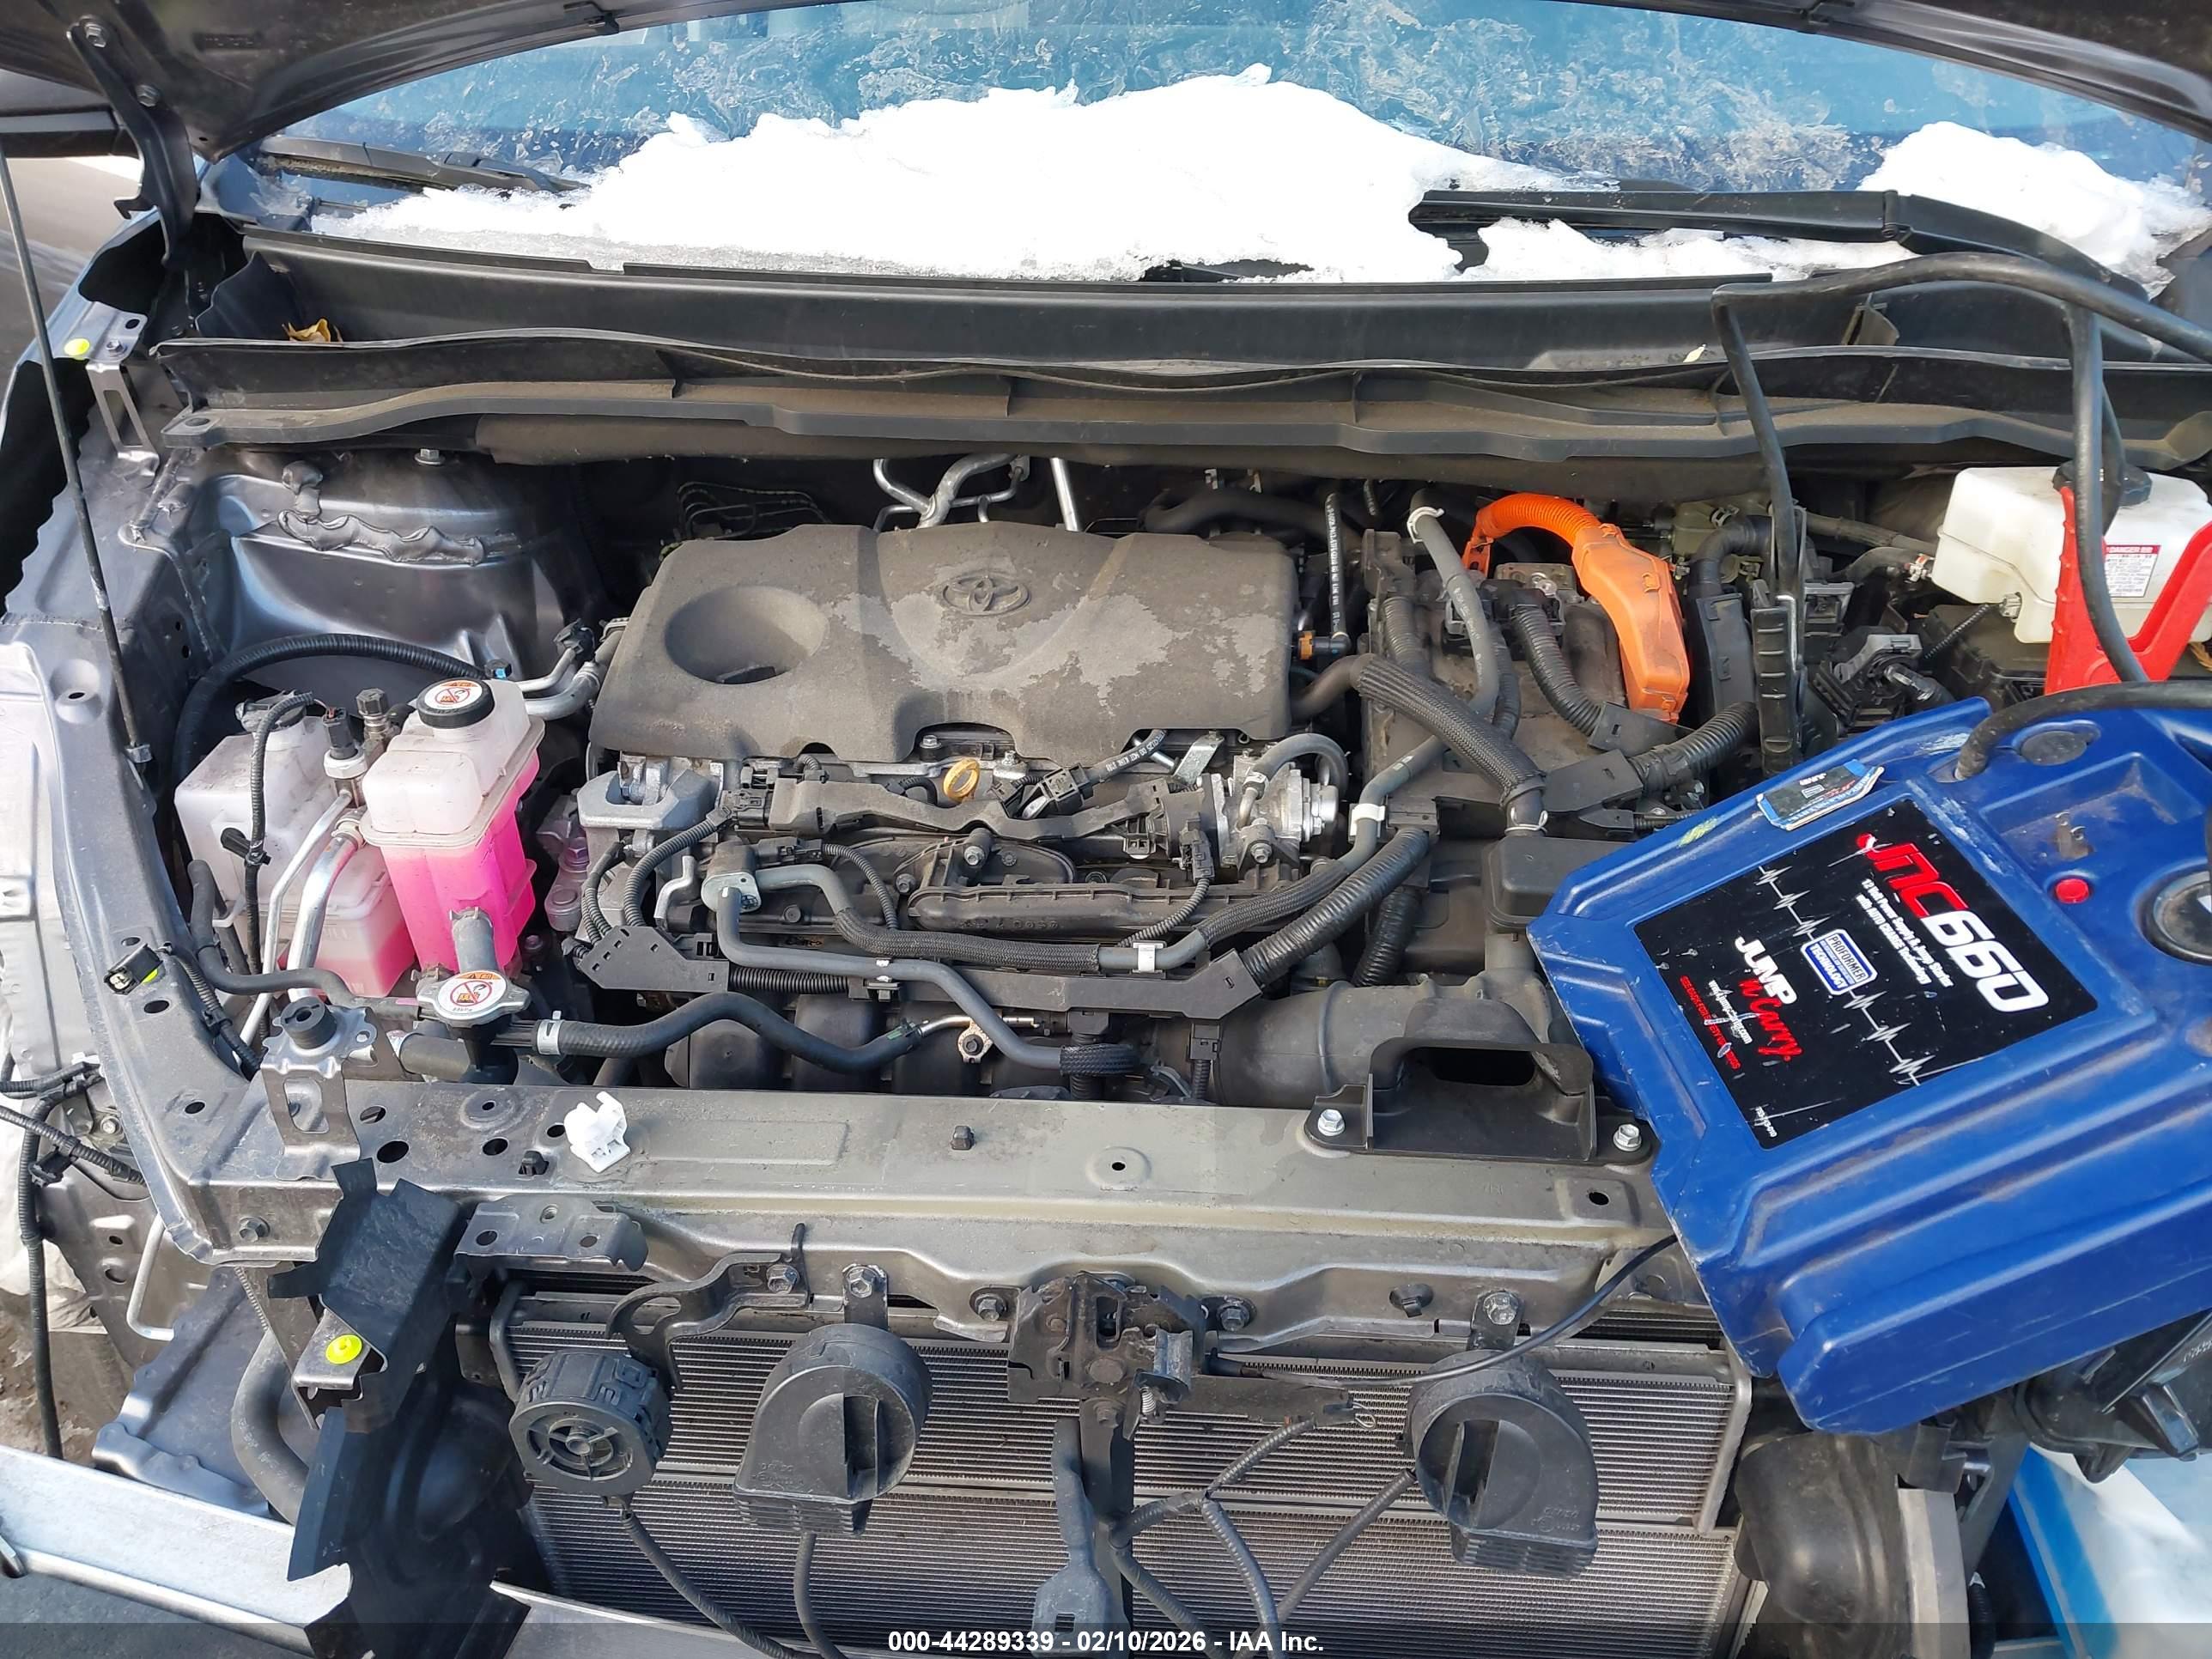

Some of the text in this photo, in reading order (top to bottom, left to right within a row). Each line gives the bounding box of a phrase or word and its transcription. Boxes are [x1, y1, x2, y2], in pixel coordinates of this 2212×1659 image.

[1828, 936, 1865, 979] PROFORMER
[1855, 893, 1931, 984] with AUTO CHARGE Technology
[1856, 833, 2049, 1012] JNC660
[1867, 885, 1884, 902] Volt
[1876, 897, 1898, 919] Power
[1892, 916, 1915, 941] Supply
[1912, 945, 1934, 964] Jump
[1928, 961, 1954, 987] Starter
[1735, 937, 1797, 1005] JUMP
[1810, 944, 1846, 988] TECHNOLOGY
